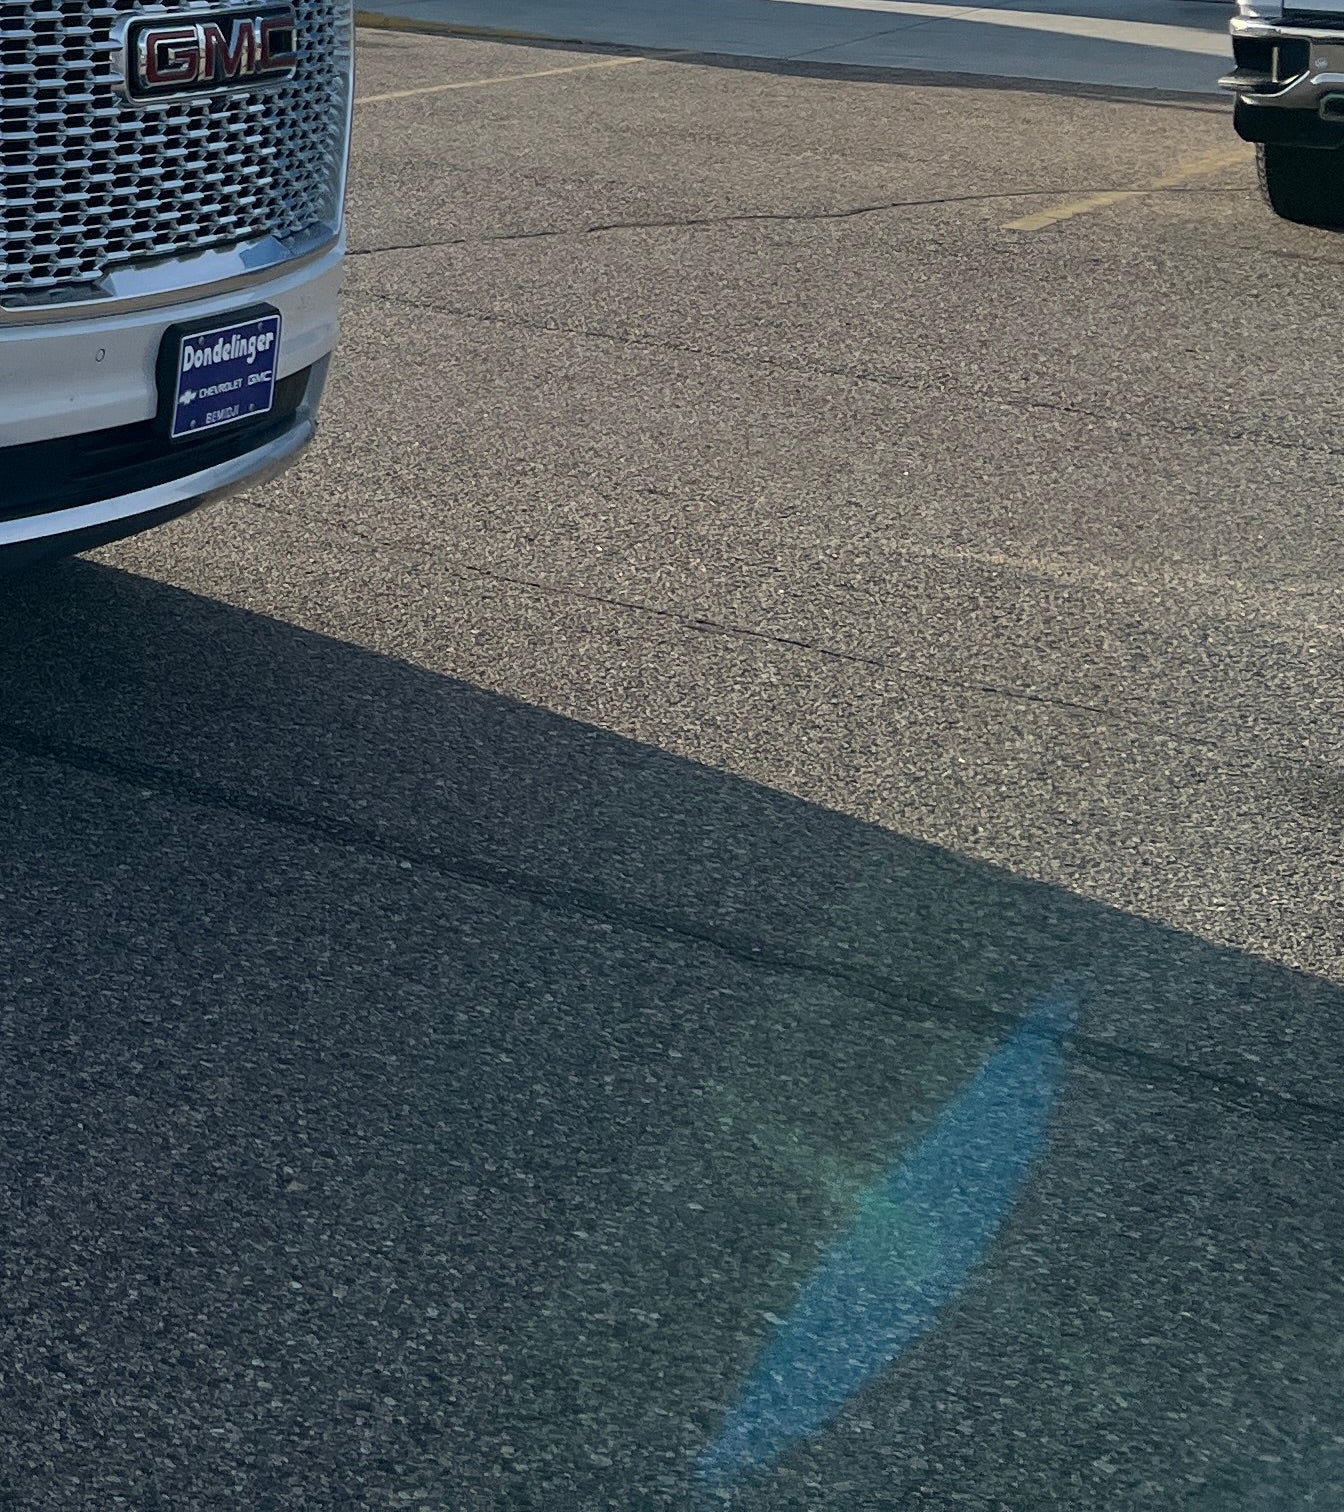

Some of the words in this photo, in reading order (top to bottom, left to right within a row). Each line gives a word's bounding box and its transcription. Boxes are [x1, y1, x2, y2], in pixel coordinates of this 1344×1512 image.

[138, 16, 298, 88] GMC
[182, 332, 274, 372] Dondelinger
[198, 378, 244, 399] CHEVROLET
[247, 370, 272, 386] GMC
[205, 404, 240, 424] BEMIDJI
